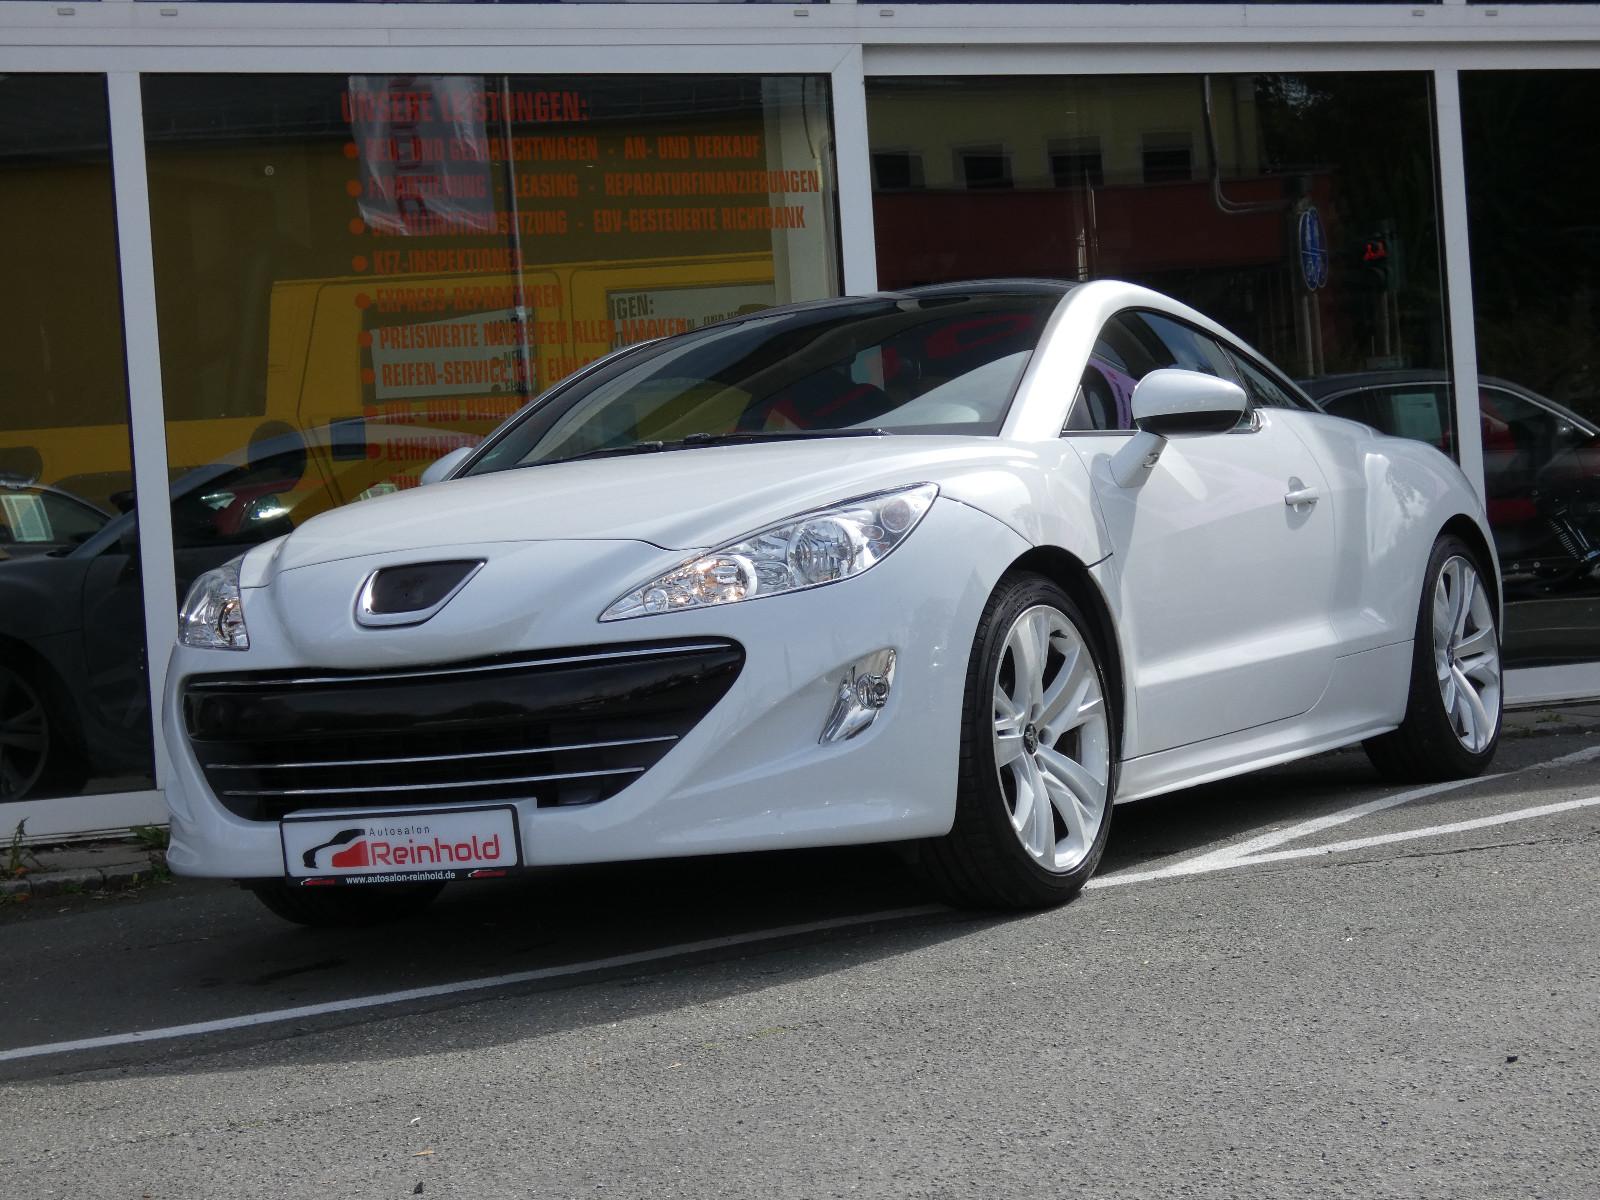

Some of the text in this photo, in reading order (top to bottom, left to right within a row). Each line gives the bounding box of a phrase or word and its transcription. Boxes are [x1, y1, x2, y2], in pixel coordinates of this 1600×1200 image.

[341, 91, 432, 122] UNSERE
[624, 136, 651, 160] AN-
[657, 136, 690, 160] UND
[695, 135, 760, 159] VERKAUF
[515, 174, 578, 199] LEASING
[604, 170, 820, 197] REPARATURFINANZIERUNGEN
[594, 208, 717, 233] EDV-GESTEUERTE
[722, 206, 806, 231] RICHTBANK
[380, 322, 480, 350] PREISWERTE
[383, 358, 511, 387] REIFEN-SERVICE
[369, 826, 431, 837] Autosalon
[371, 834, 501, 866] Reinhold
[346, 871, 456, 885] www.autosalon-reinhold.de
